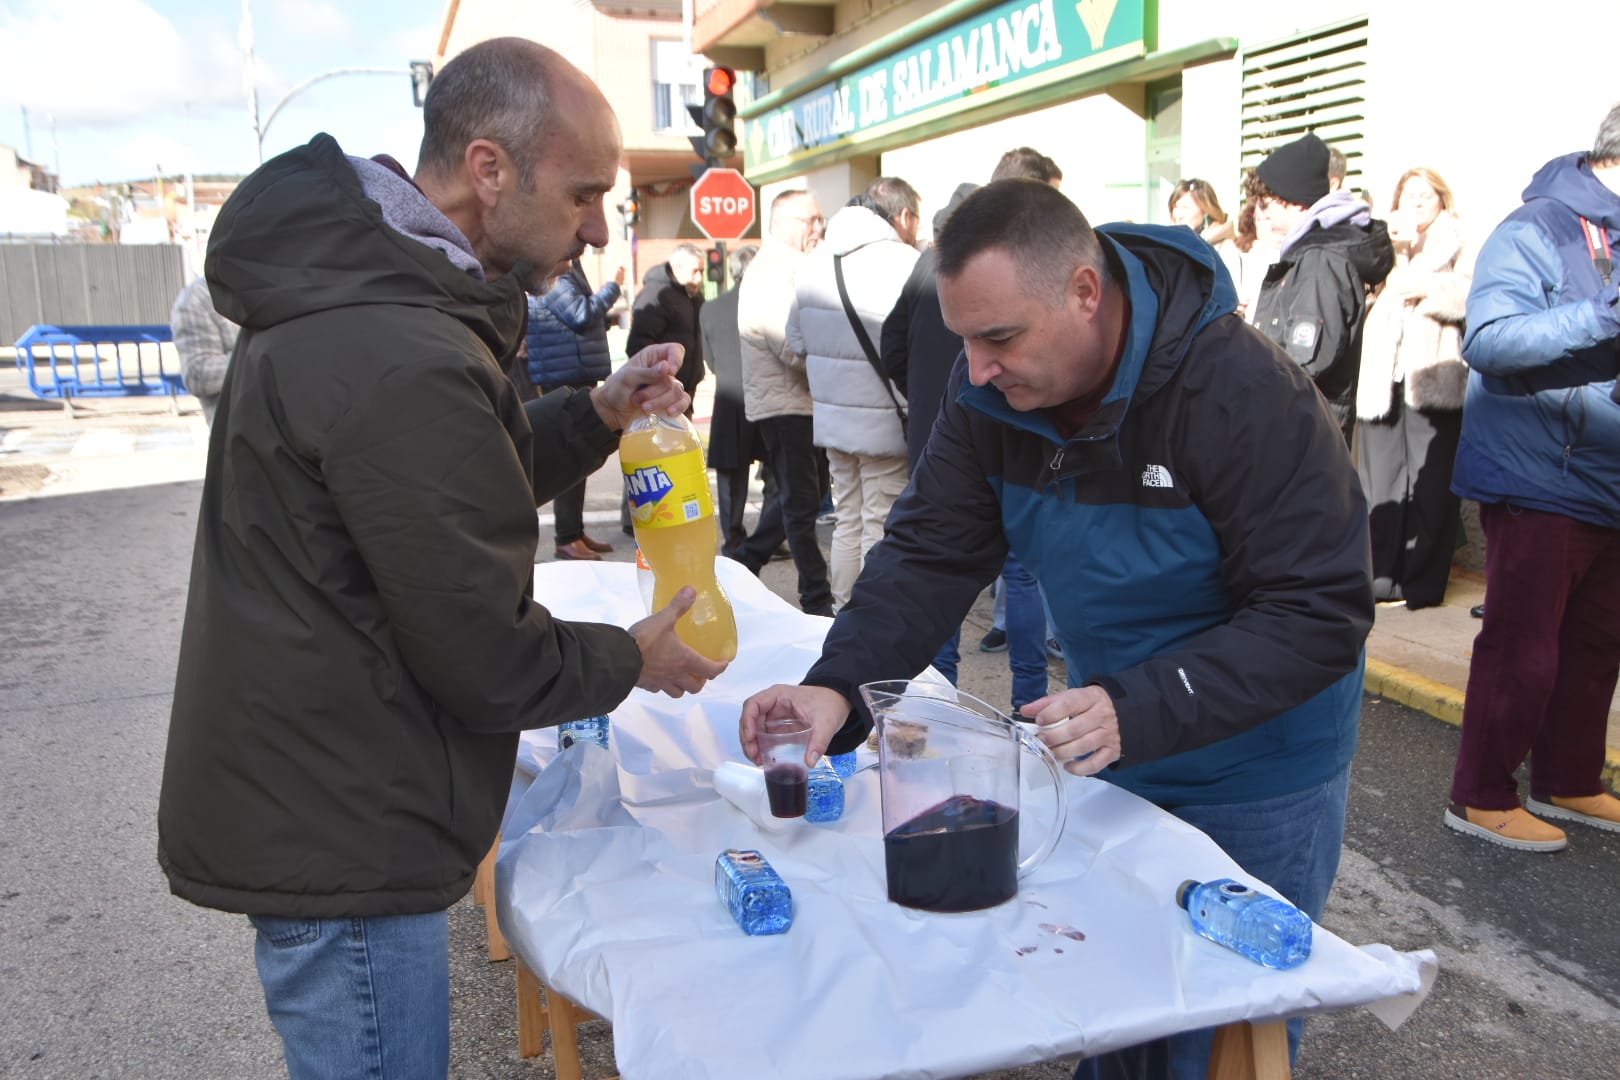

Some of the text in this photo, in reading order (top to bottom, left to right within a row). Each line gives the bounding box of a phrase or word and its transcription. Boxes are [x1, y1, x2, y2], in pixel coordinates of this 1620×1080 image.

[803, 85, 855, 144] RURAL
[858, 69, 888, 128] DE
[893, 0, 1063, 116] SALAMANCA
[699, 196, 749, 215] STOP
[1146, 464, 1160, 472] THE
[625, 467, 671, 496] ANTA
[1141, 471, 1160, 480] ORTH
[1142, 479, 1160, 487] FACE
